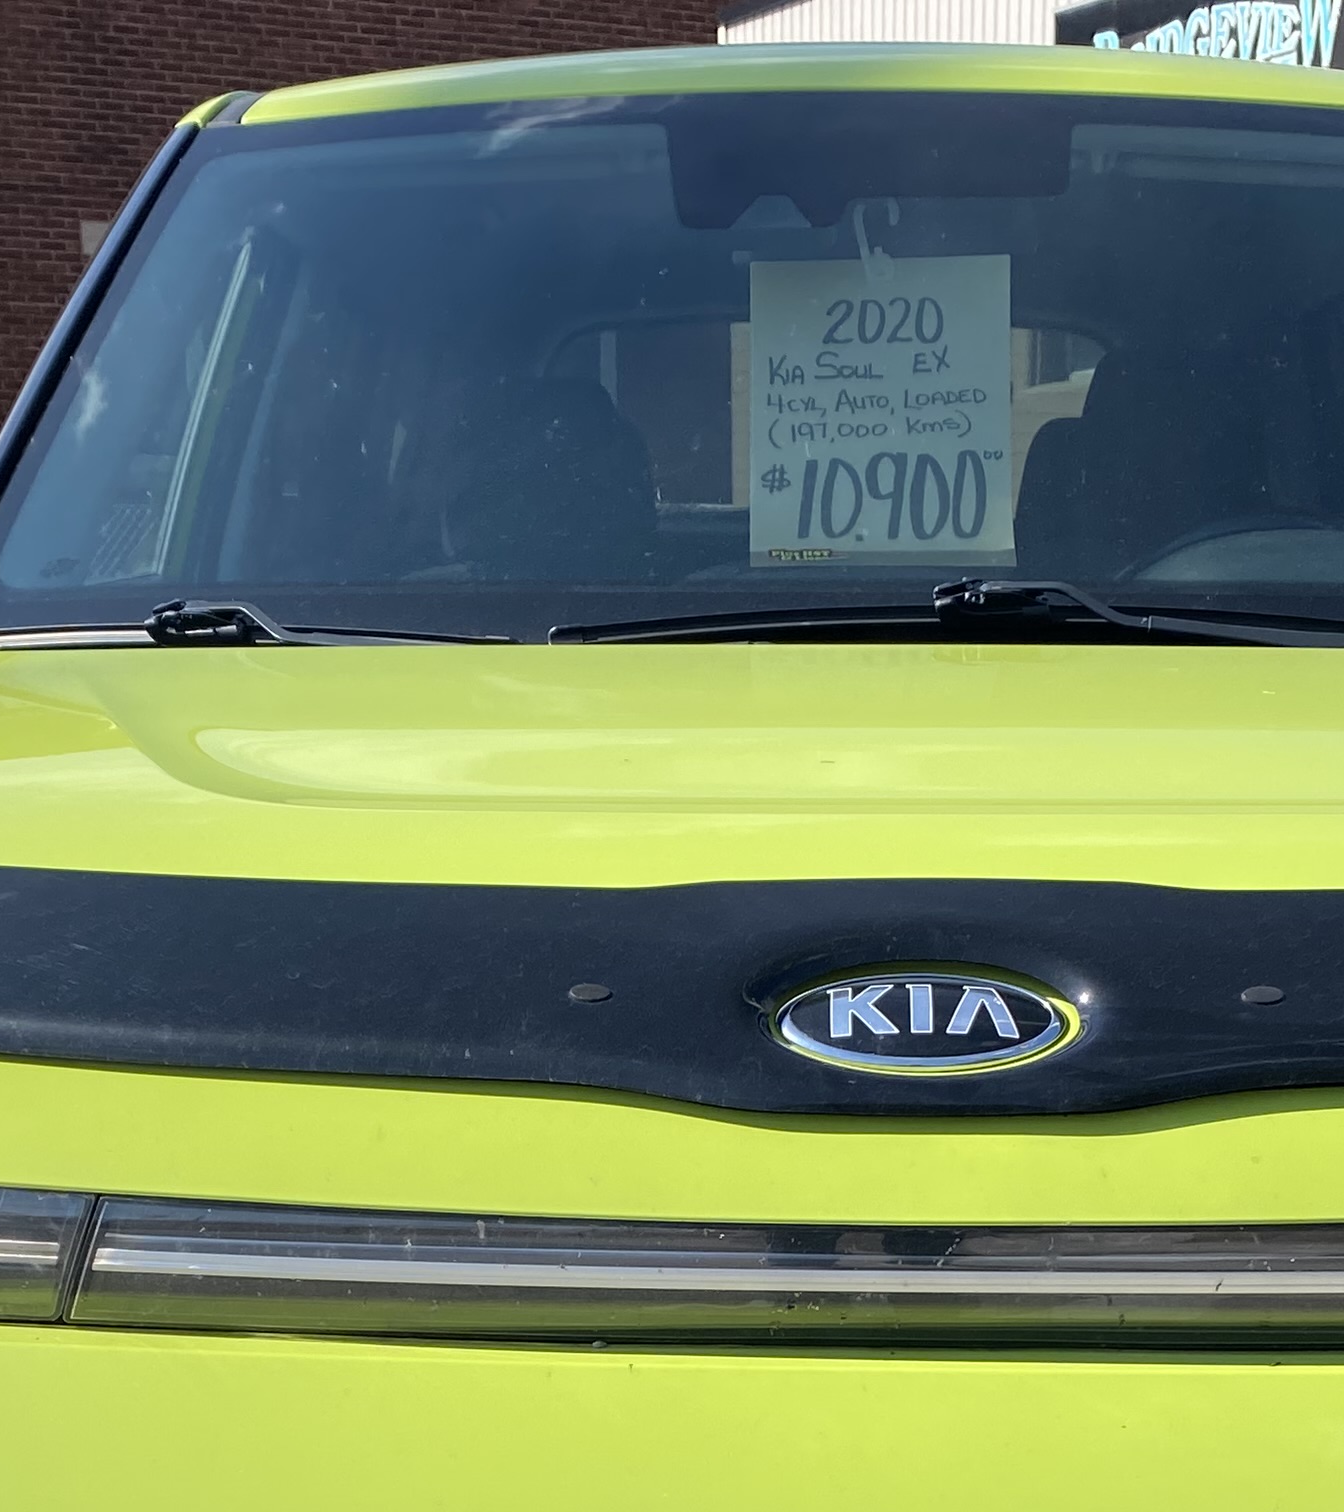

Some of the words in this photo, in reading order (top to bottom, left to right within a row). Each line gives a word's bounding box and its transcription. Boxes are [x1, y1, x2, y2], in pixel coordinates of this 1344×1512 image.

[1093, 0, 1342, 68] DGEVIEW
[822, 297, 944, 344] 2020
[913, 345, 951, 375] EX
[904, 388, 987, 410] LOADED
[827, 984, 1020, 1039] KIA
